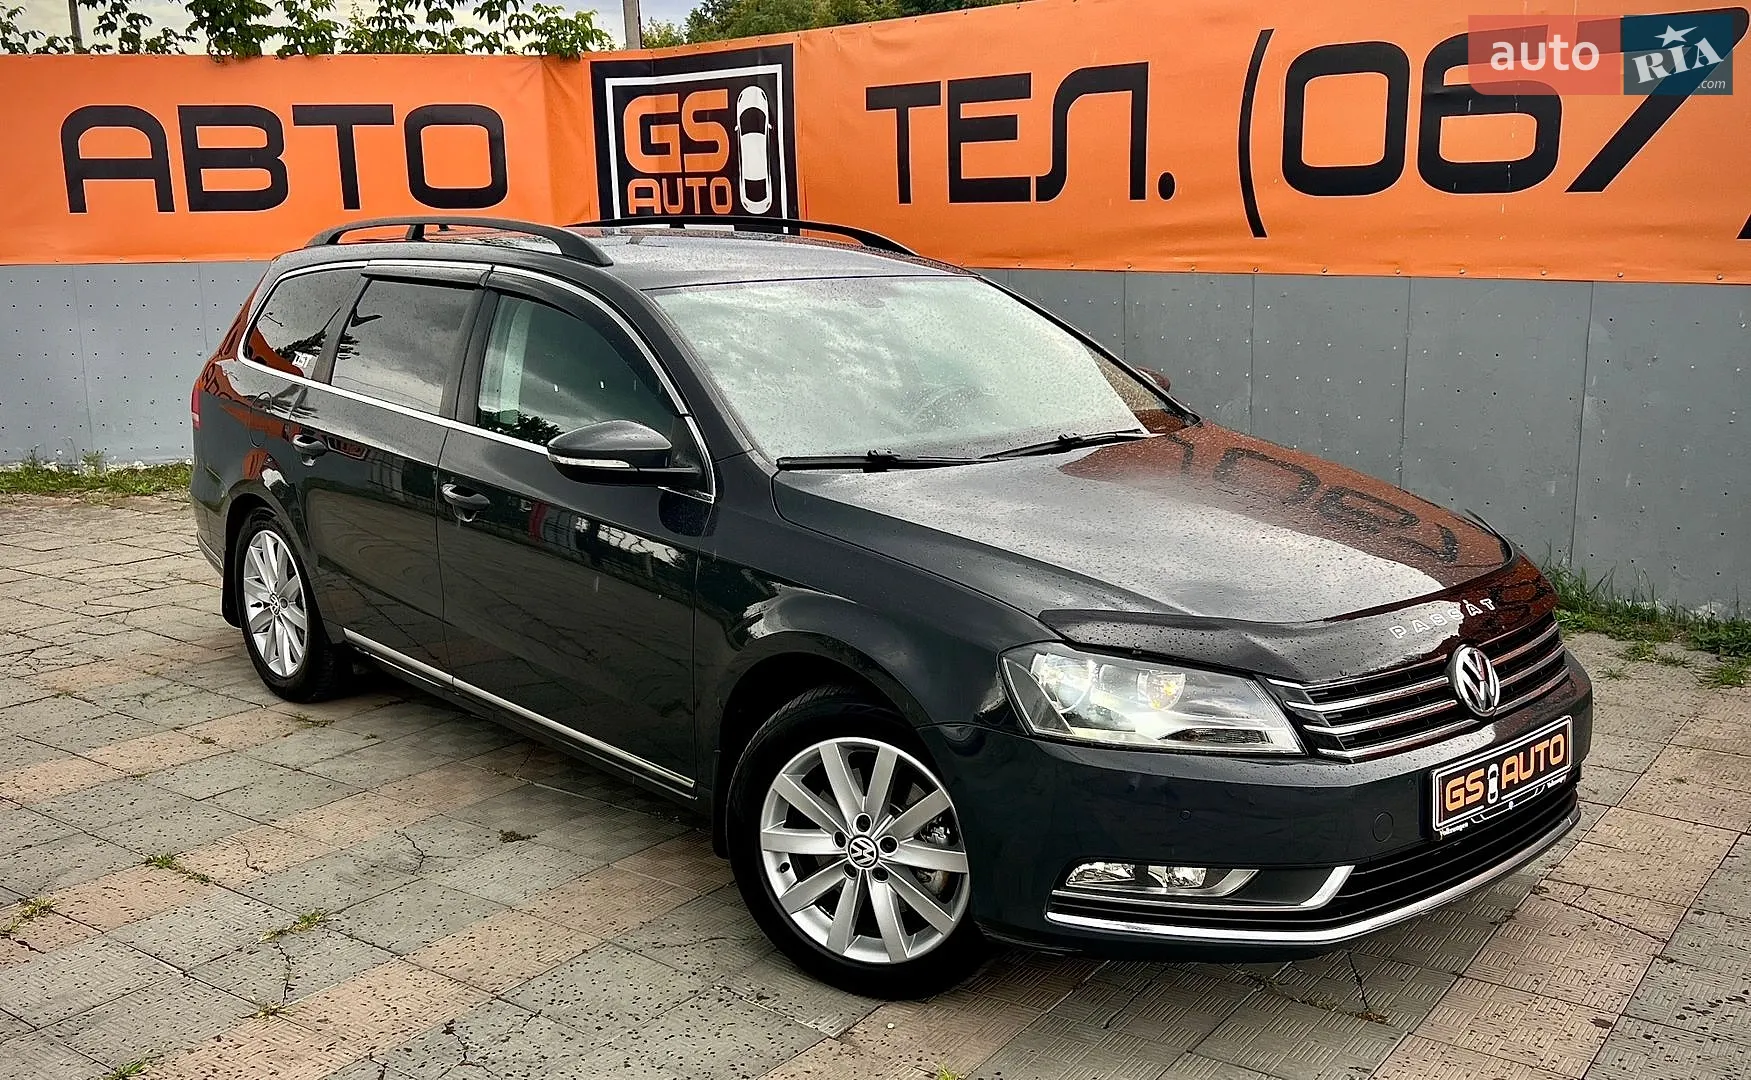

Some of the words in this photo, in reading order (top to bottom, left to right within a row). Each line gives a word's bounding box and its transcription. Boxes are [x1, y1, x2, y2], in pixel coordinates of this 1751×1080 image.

[61, 104, 507, 213] АВТО
[625, 89, 729, 172] GS
[865, 61, 1177, 204] ТЕЛ.
[628, 177, 732, 214] AUTO
[1389, 598, 1496, 639] PASSAT
[1445, 768, 1485, 811] GS
[1501, 733, 1564, 790] AUTO
